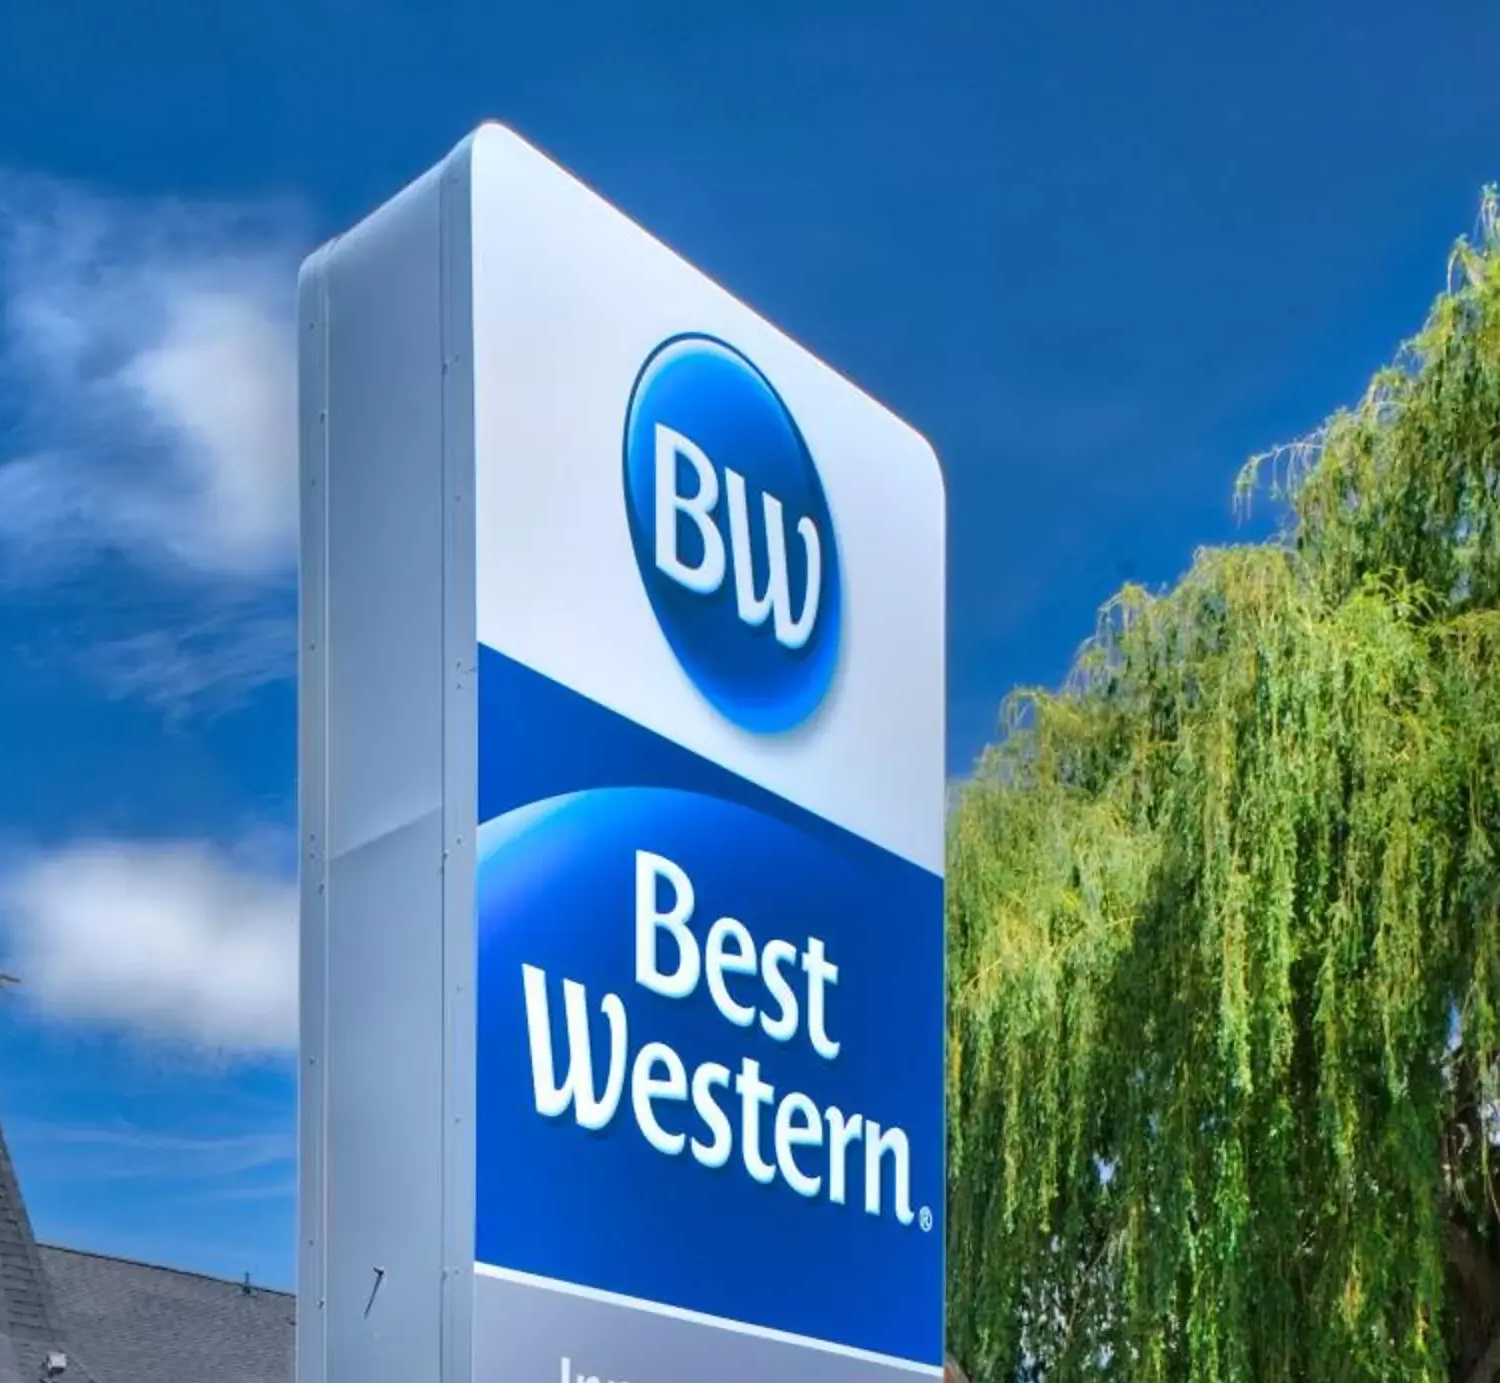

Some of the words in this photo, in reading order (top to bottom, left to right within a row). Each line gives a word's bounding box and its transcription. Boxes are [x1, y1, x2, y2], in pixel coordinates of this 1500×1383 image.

[655, 421, 821, 649] BW
[635, 849, 840, 1060] Best
[521, 963, 914, 1227] Western
